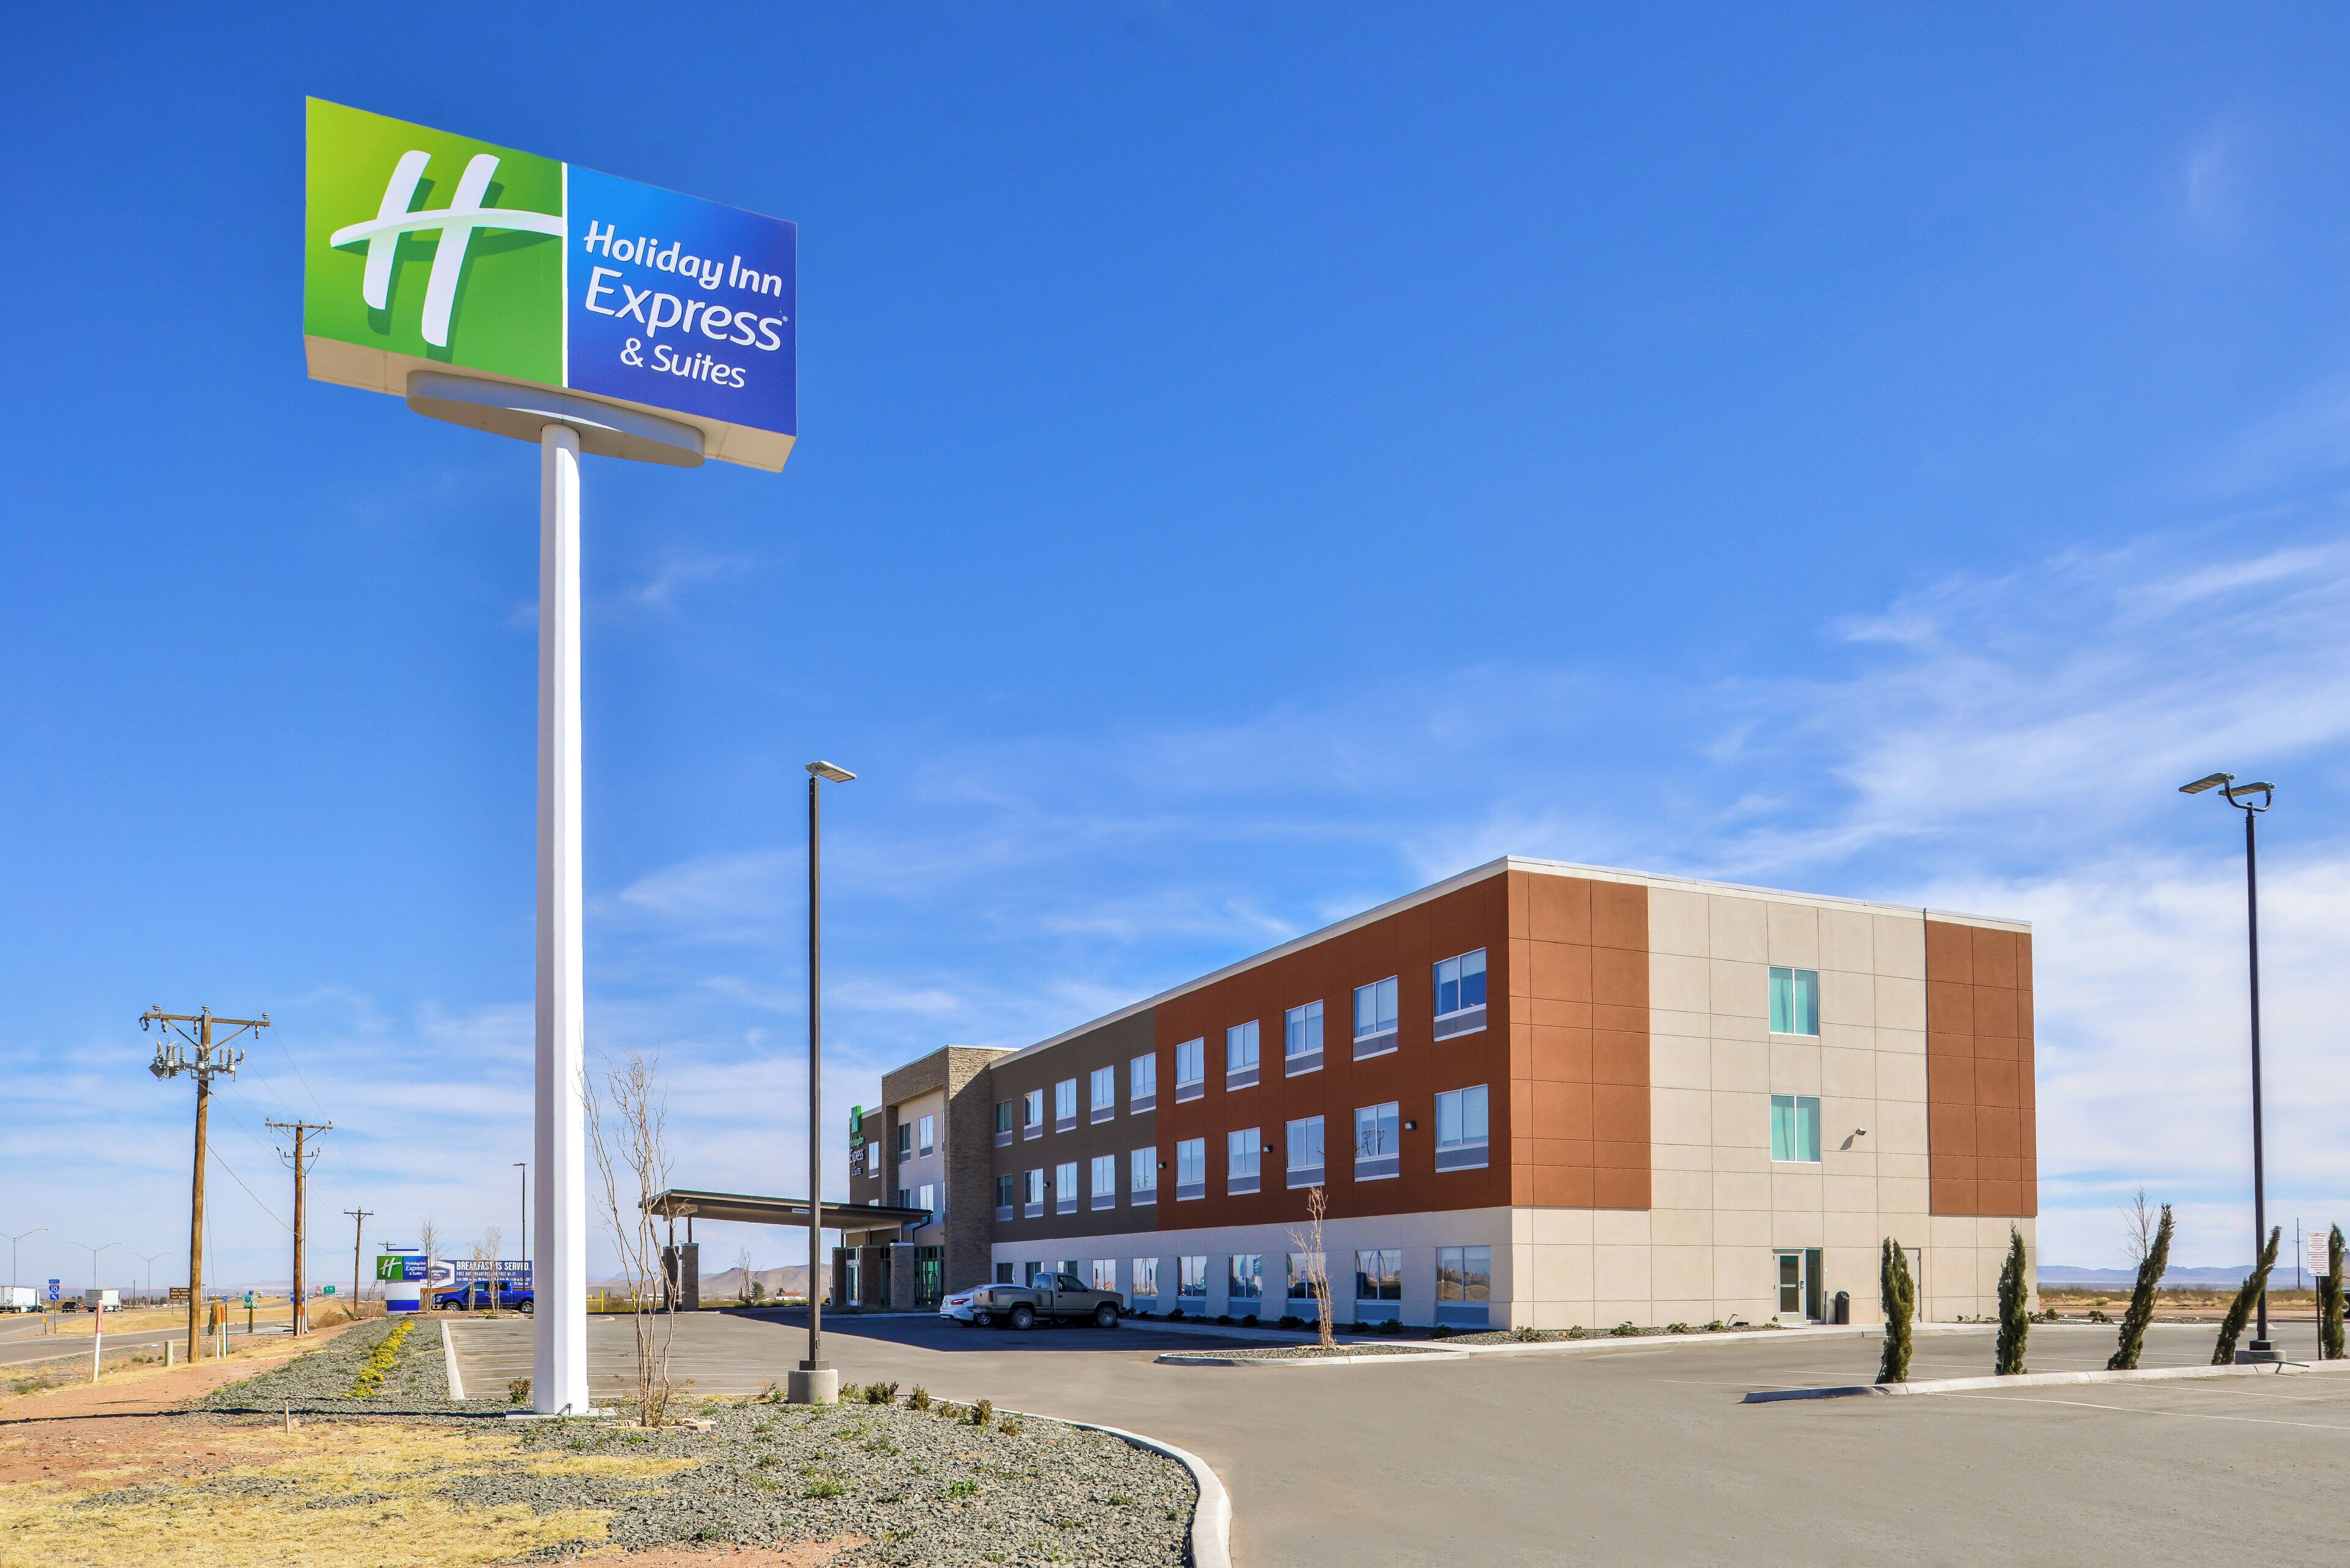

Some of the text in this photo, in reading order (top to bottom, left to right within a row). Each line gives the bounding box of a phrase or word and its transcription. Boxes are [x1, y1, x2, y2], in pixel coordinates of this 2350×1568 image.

[583, 220, 783, 297] Holiday Inn
[620, 337, 746, 388] & Suites
[849, 1149, 864, 1166] Express
[457, 1261, 493, 1271] BREAKFAST
